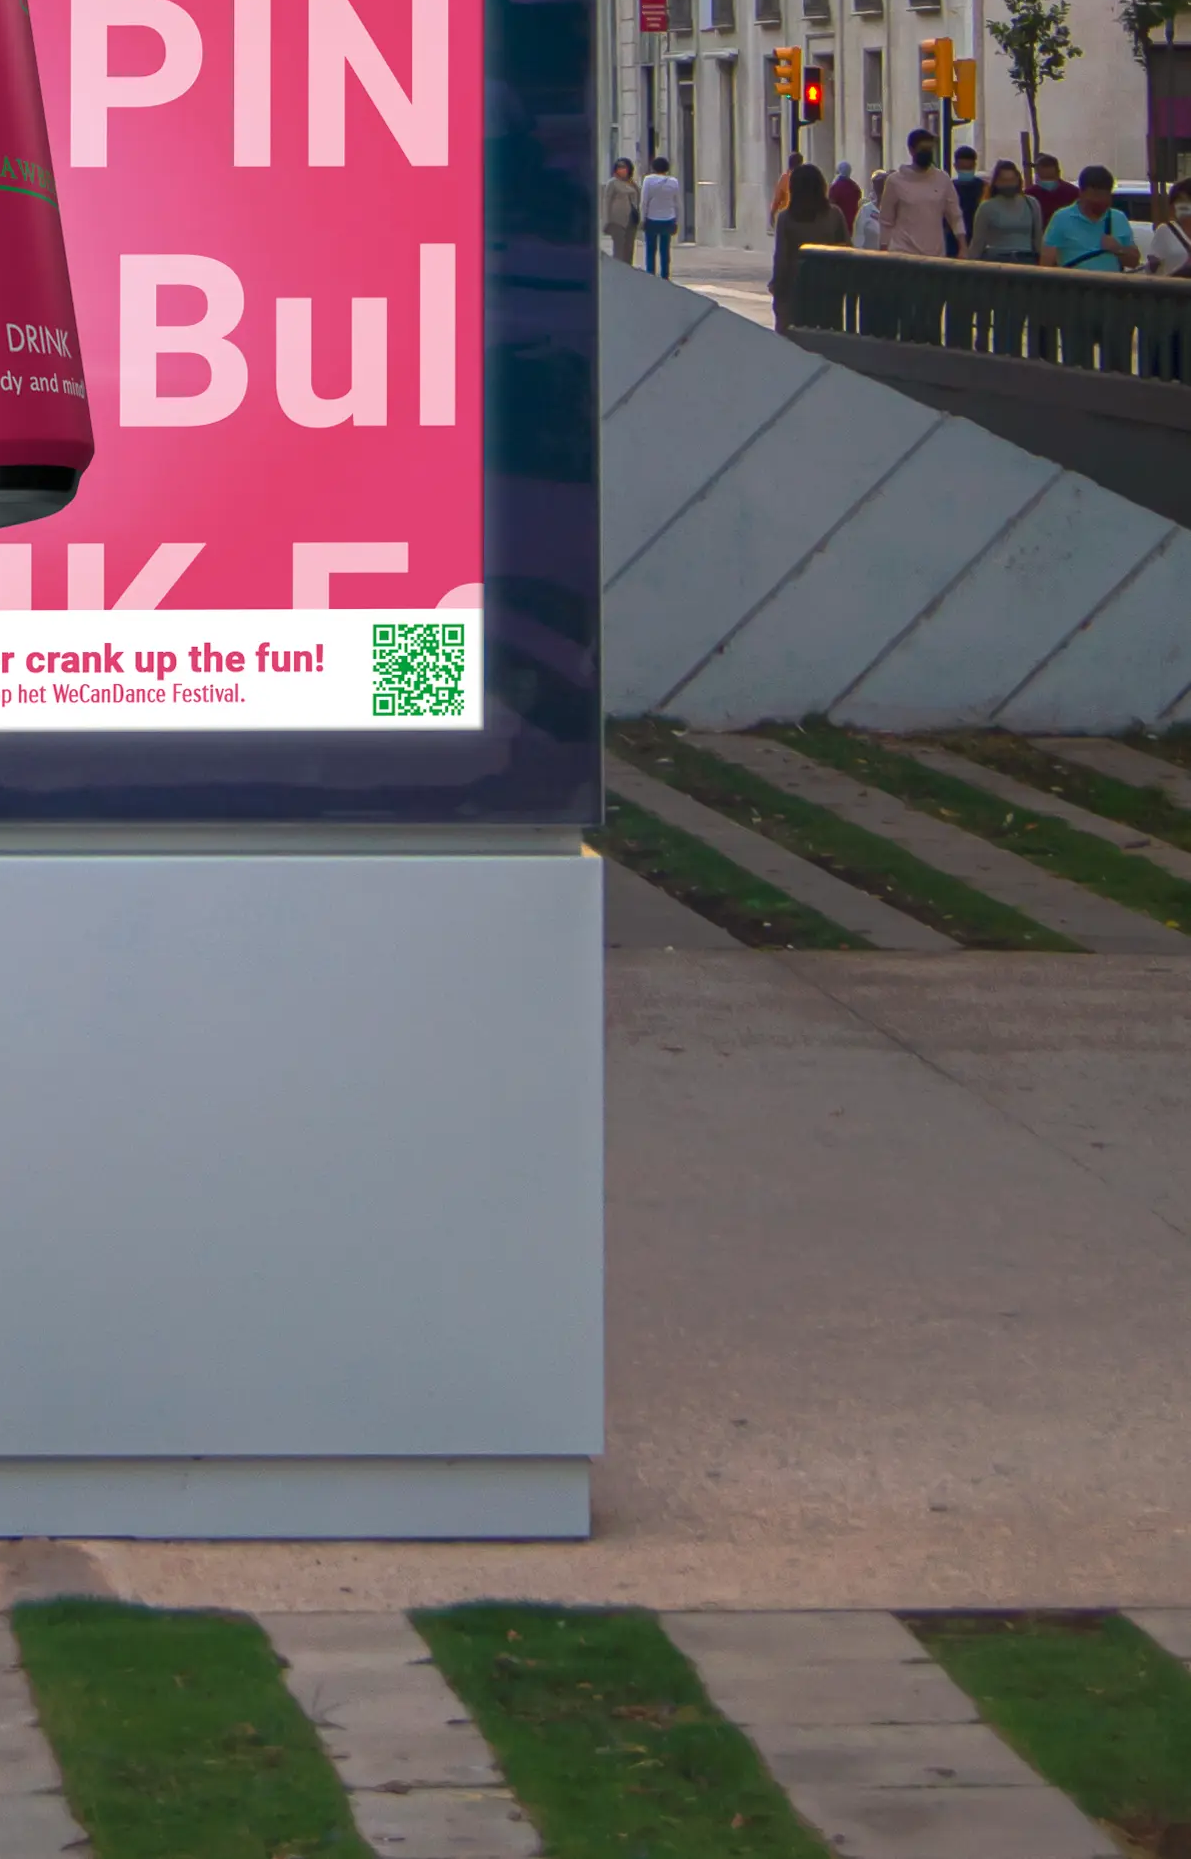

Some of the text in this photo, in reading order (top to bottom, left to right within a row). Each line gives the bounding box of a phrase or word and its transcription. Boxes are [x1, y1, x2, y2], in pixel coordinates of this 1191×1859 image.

[6, 323, 73, 359] DRINK
[119, 244, 457, 429] Bul
[30, 373, 59, 393] and
[25, 643, 125, 674] crank
[135, 651, 178, 681] up
[188, 642, 246, 673] the
[255, 642, 324, 672] fun!
[18, 684, 47, 704] het
[53, 683, 166, 704] WeCanDance
[173, 683, 246, 704] Festival.
